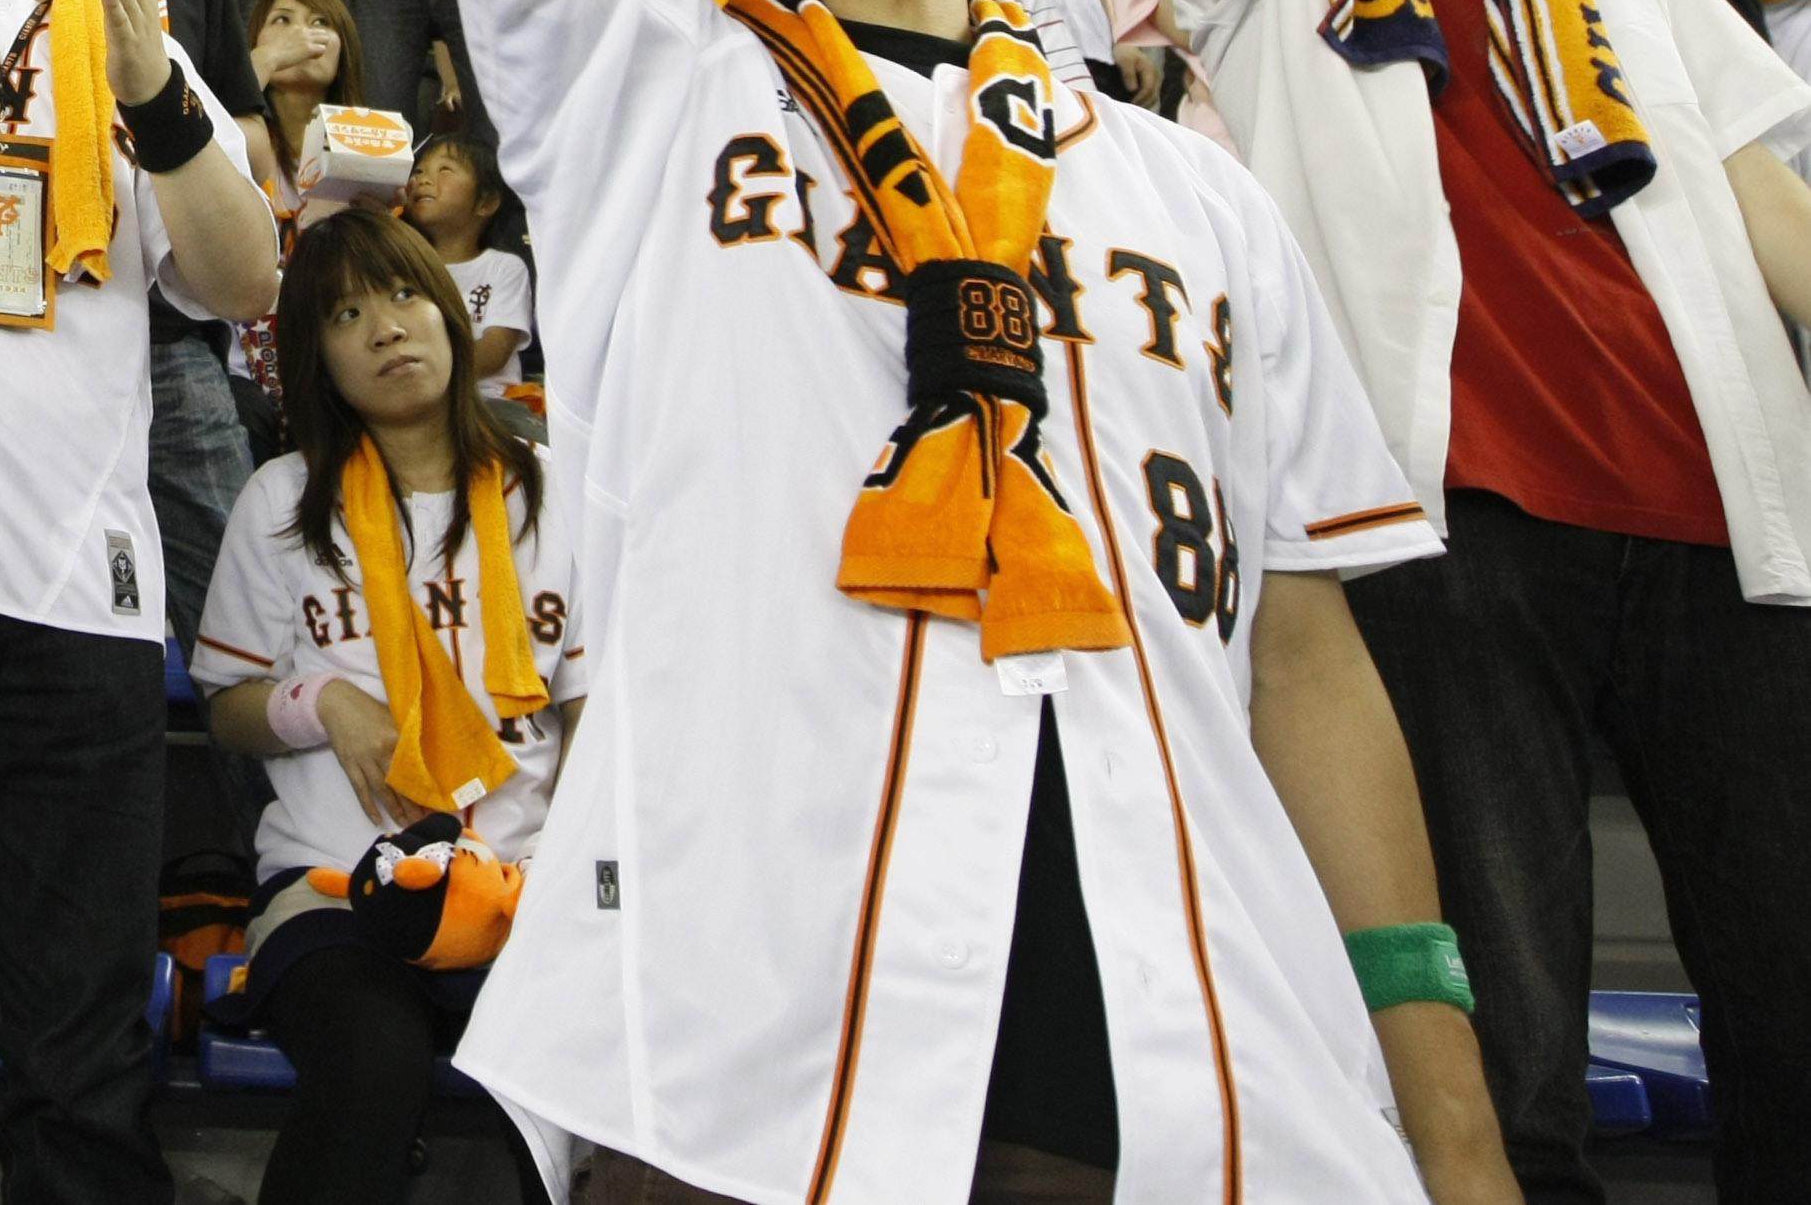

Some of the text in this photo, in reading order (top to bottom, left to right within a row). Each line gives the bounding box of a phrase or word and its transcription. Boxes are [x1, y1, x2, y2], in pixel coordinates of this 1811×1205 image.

[957, 278, 1032, 349] 88
[1139, 448, 1241, 647] 88
[302, 578, 567, 648] GINS
